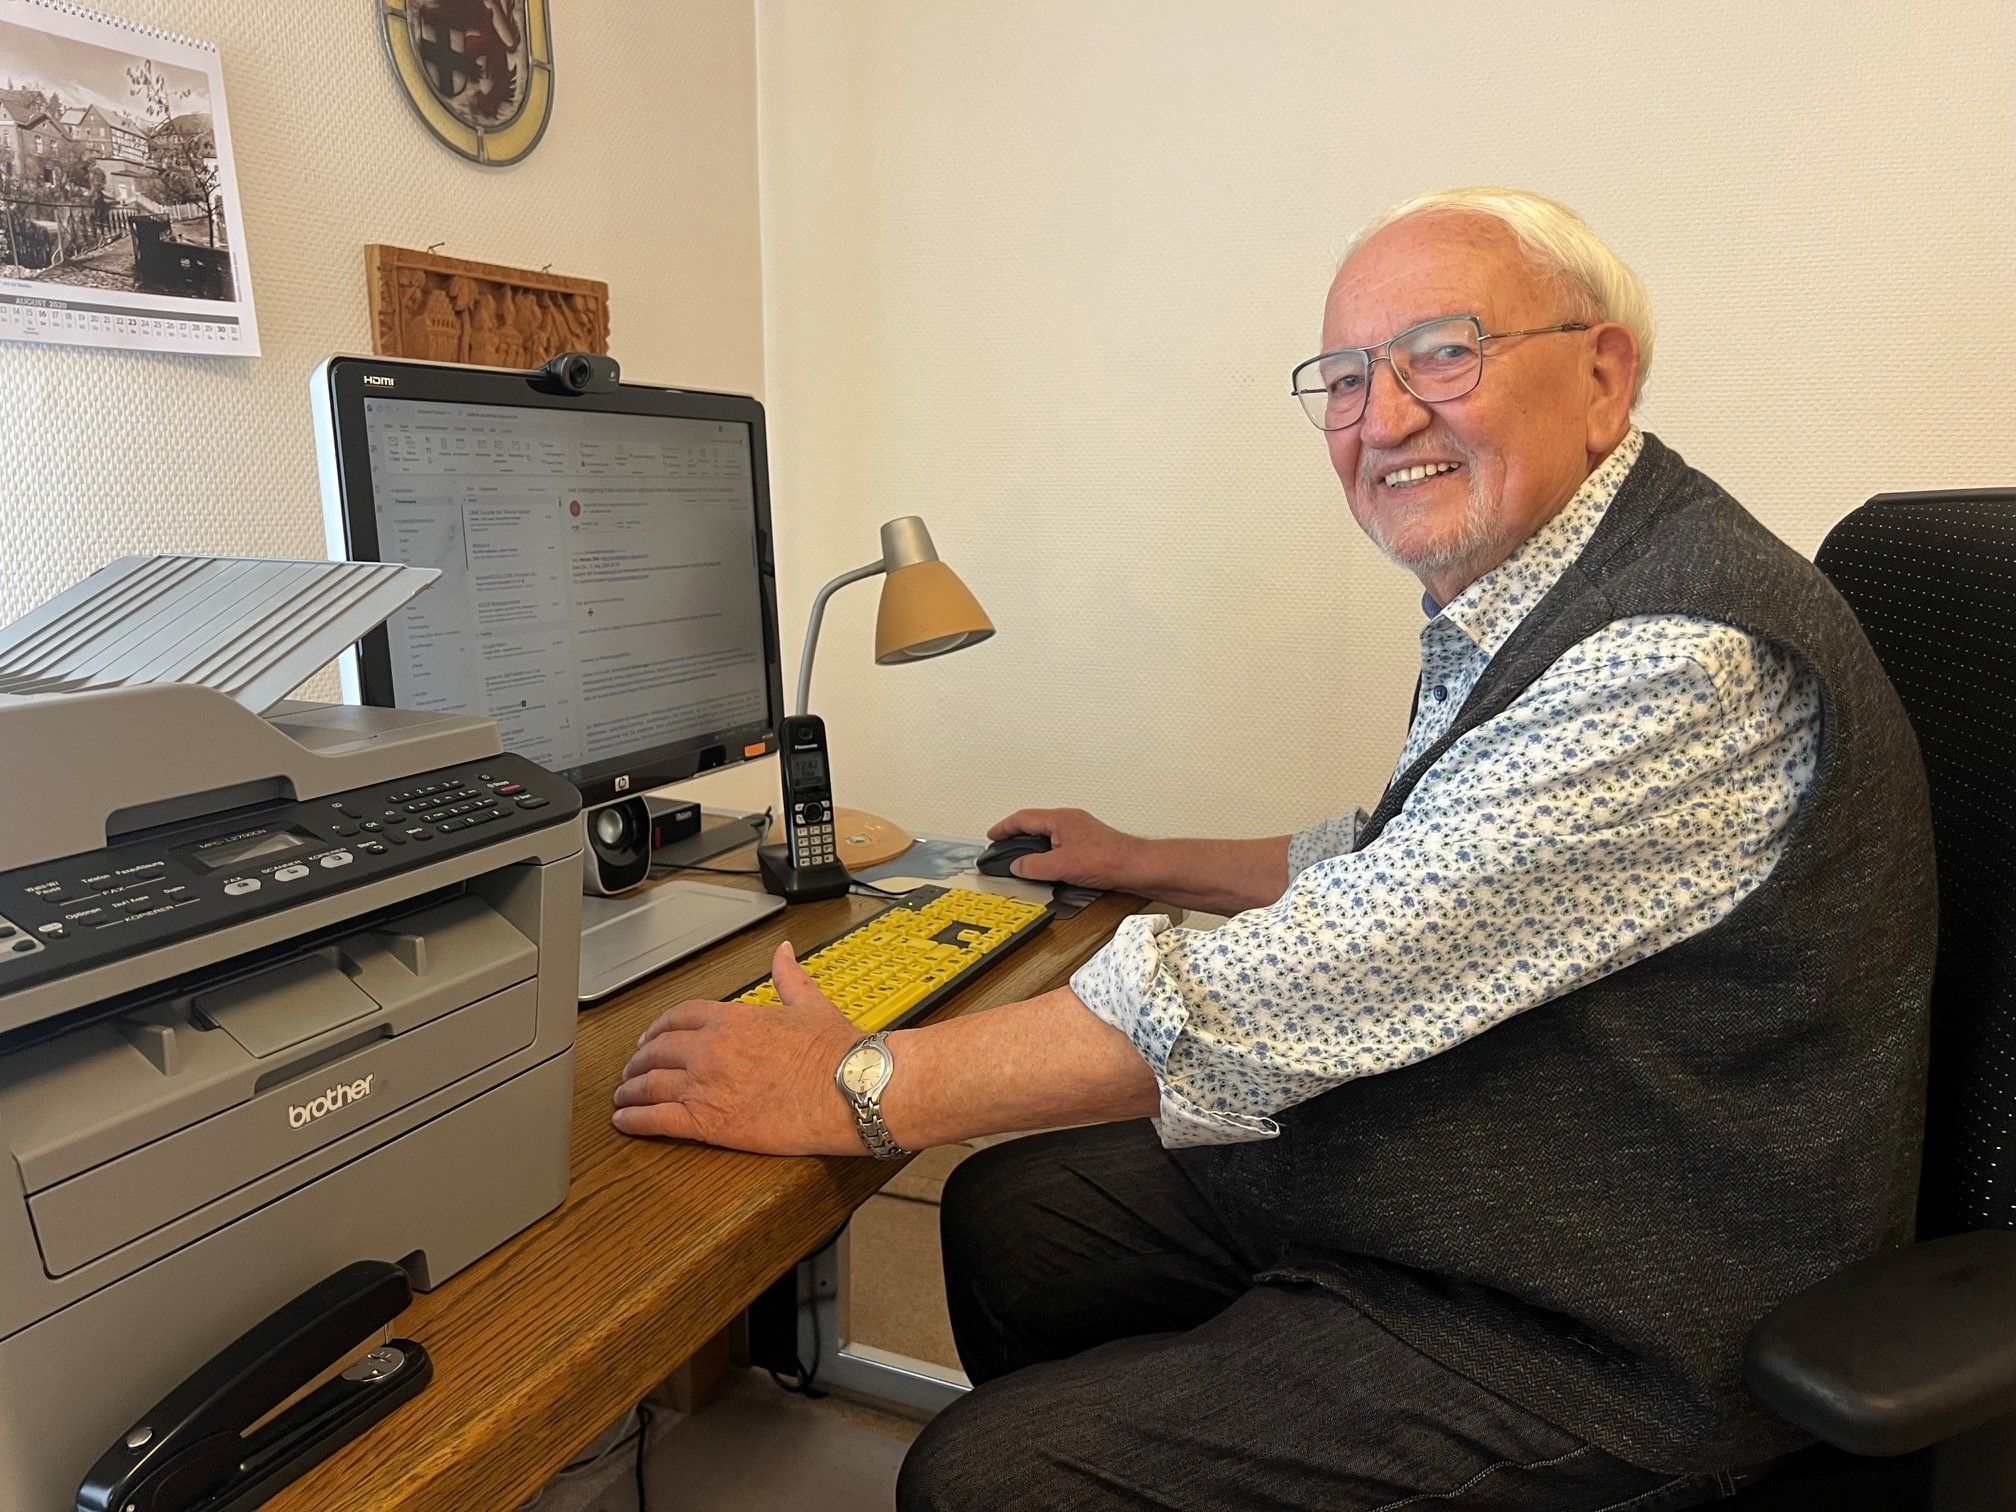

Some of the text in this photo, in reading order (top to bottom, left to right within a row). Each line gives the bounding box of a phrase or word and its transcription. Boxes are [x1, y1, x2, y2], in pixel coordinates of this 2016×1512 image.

[16, 297, 47, 308] AUGUST
[128, 318, 137, 326] 23
[364, 375, 395, 386] HDMI
[365, 821, 378, 829] OK
[261, 859, 303, 874] SCANNER
[81, 874, 111, 884] Telefon
[223, 876, 243, 884] FAX
[102, 887, 127, 896] FAX
[65, 907, 102, 920] Optionen
[124, 905, 175, 922] KOPIERER
[288, 1073, 374, 1128] brother
